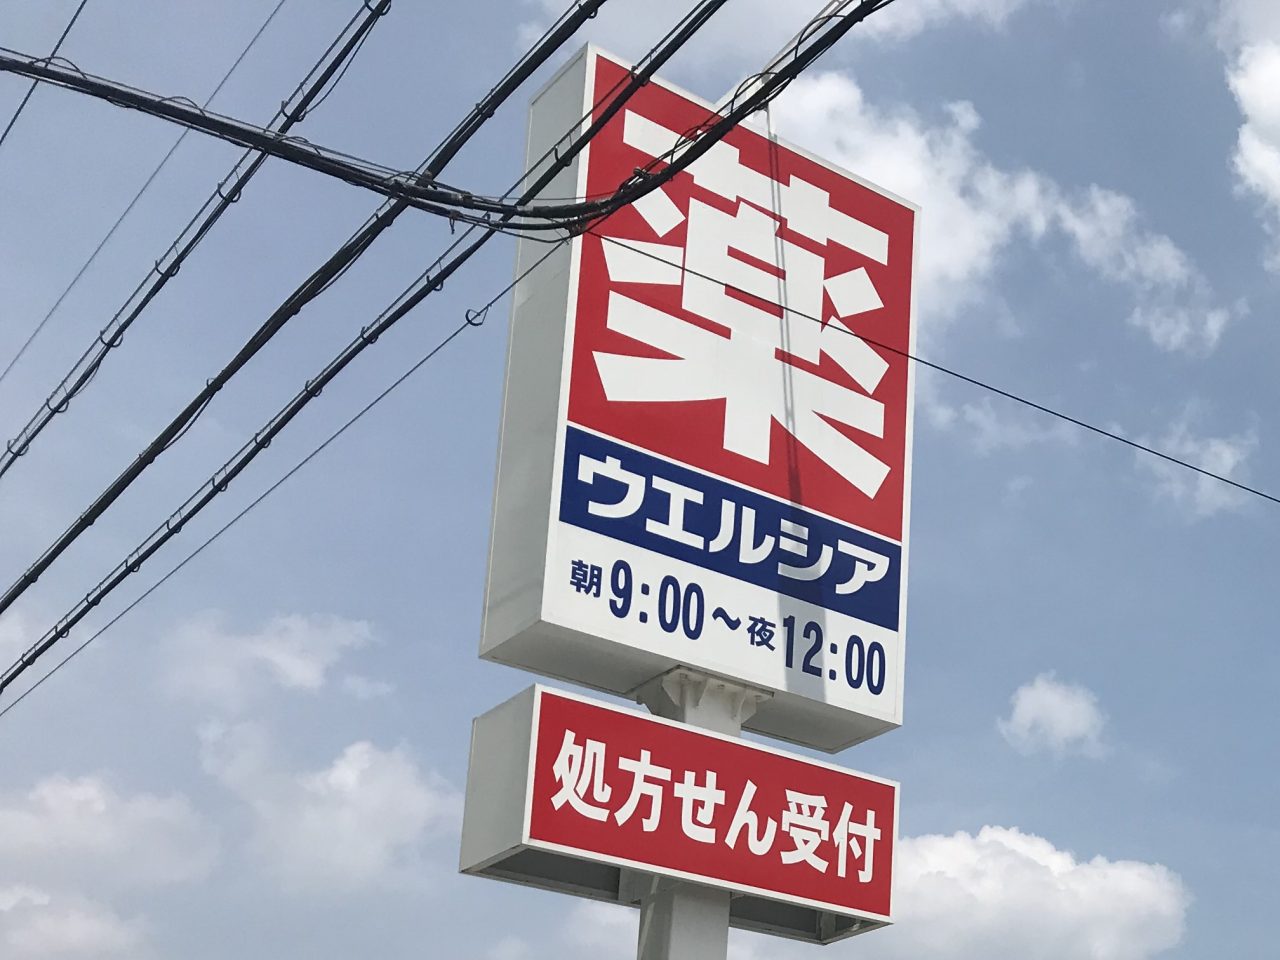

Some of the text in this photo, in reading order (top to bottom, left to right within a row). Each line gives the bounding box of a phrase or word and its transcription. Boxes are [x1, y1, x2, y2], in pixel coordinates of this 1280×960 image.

[590, 108, 891, 500] 薬
[576, 453, 891, 596] ウエルシア
[550, 729, 882, 883] 処方せん受付
